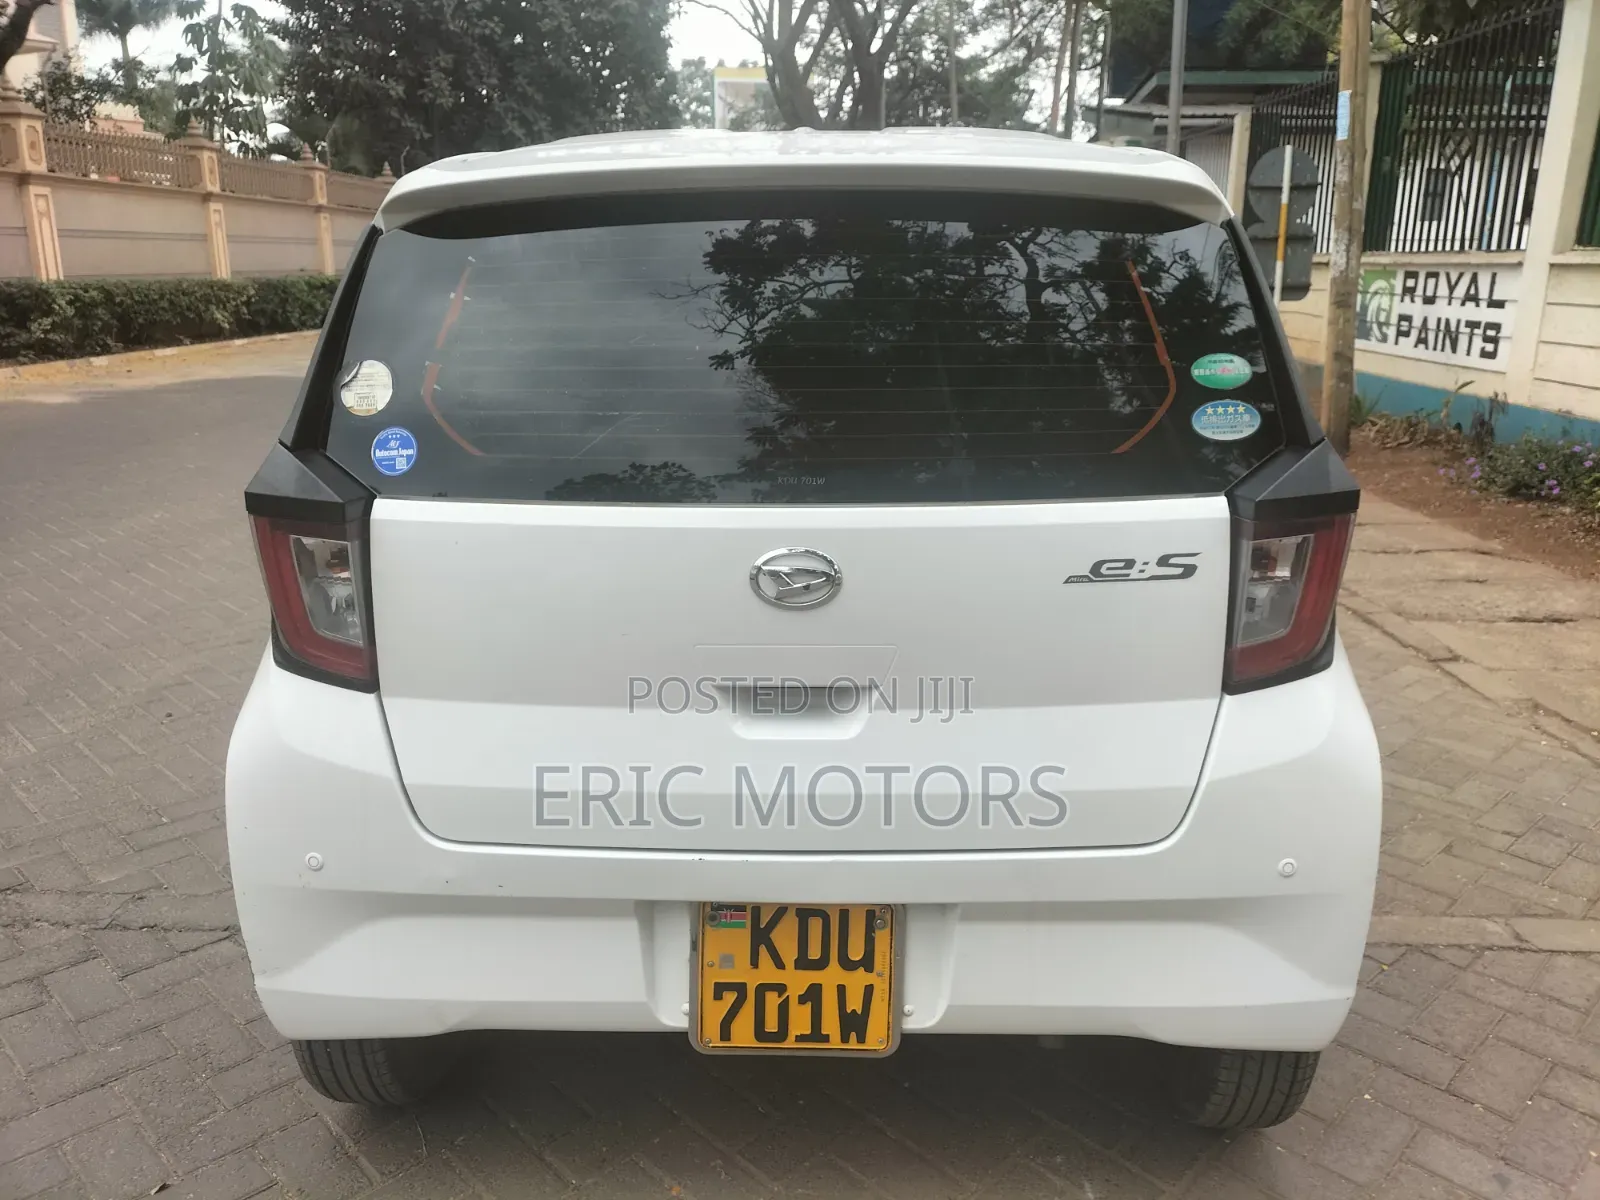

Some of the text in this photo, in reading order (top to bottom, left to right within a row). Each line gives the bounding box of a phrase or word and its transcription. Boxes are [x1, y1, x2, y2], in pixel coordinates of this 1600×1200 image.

[1400, 270, 1508, 309] ROYAL
[1394, 313, 1502, 360] PAINTS
[399, 447, 414, 457] Japan
[800, 476, 826, 485] 701W
[749, 905, 877, 973] KDU
[713, 981, 875, 1043] 701W
